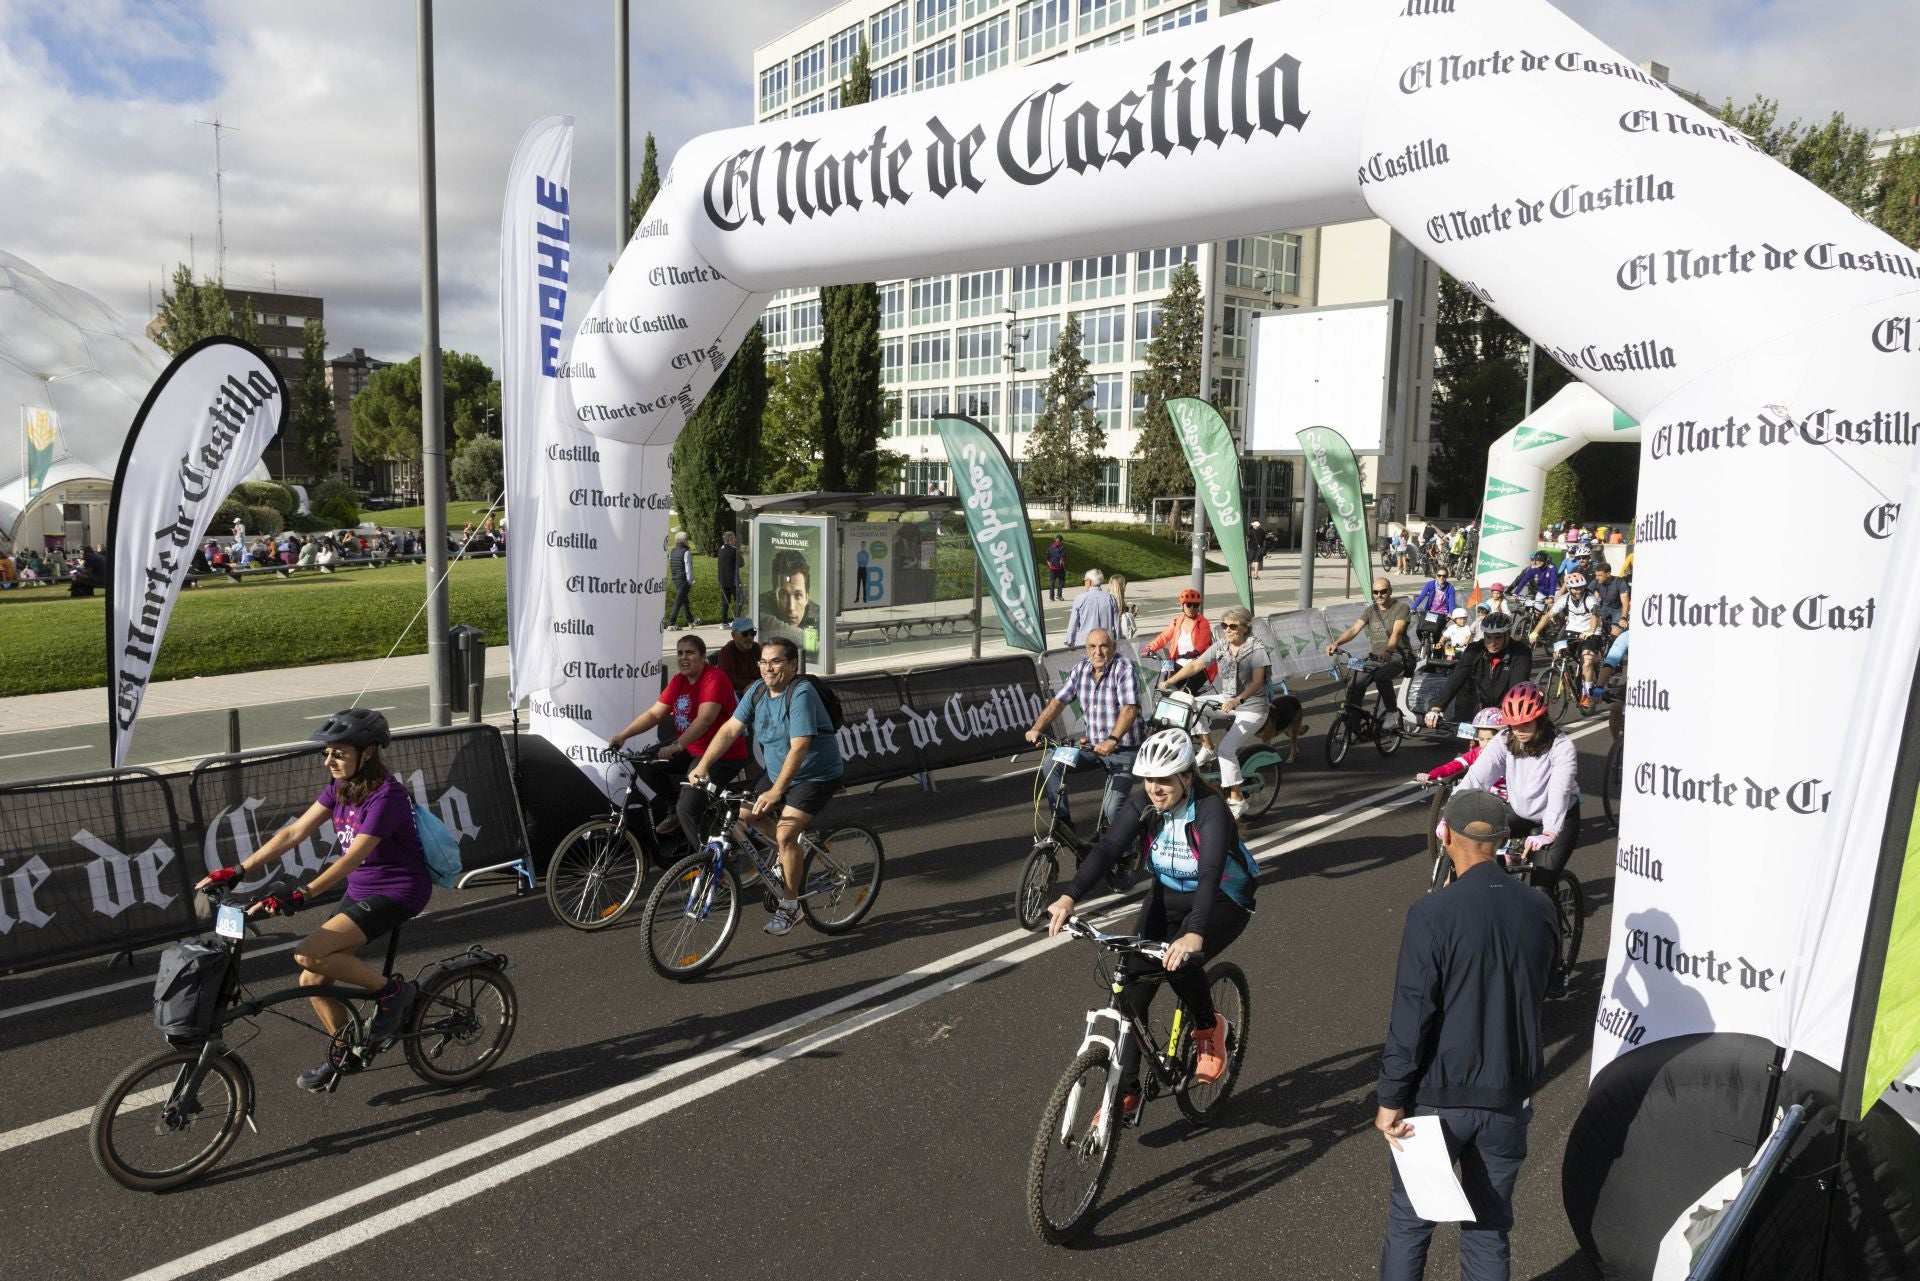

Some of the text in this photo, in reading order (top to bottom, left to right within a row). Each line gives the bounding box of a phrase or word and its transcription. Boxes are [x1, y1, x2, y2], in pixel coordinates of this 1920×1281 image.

[1400, 49, 1664, 94] El Norte de Castilla
[704, 37, 1310, 231] El Norte de Castilla
[1619, 109, 1740, 146] El Norte
[1368, 138, 1450, 182] Castilla
[1426, 174, 1677, 244] El Norte de Castilla
[649, 266, 667, 286] El
[667, 266, 708, 285] Norte
[1616, 254, 1655, 290] El
[1662, 245, 1755, 285] Norte
[1762, 243, 1799, 271] de
[615, 318, 628, 334] de
[629, 314, 688, 334] Castilla
[1872, 317, 1911, 353] El
[671, 353, 692, 369] El
[1581, 339, 1677, 371] Castilla
[577, 402, 654, 421] El Norte de
[179, 369, 279, 503] Castilla
[548, 443, 600, 462] Castilla
[1652, 425, 1672, 460] El
[1677, 415, 1752, 455] Norte
[1757, 414, 1794, 447] de
[569, 489, 588, 506] El
[591, 489, 630, 508] Norte
[632, 493, 646, 509] de
[547, 531, 598, 550] Castilla
[772, 537, 808, 547] PARADIGME
[566, 575, 584, 593] El
[588, 576, 628, 594] Norte
[630, 579, 643, 594] de
[867, 566, 884, 602] B
[124, 547, 180, 664] Norte
[1641, 594, 1662, 629] El
[1667, 594, 1745, 629] Norte
[1749, 596, 1787, 629] de
[553, 617, 594, 636] astilla
[563, 661, 581, 678] El
[584, 662, 624, 679] Norte
[626, 663, 640, 679] de
[118, 669, 147, 731] El
[543, 701, 592, 720] Castilla
[1626, 679, 1670, 713] astilla
[836, 708, 900, 762] orte
[900, 704, 943, 749] de
[566, 744, 583, 761] El
[1635, 762, 1656, 795] El
[1659, 763, 1738, 807] Norte
[1744, 776, 1780, 811] de
[72, 828, 180, 919] de
[1617, 842, 1664, 883] astilla
[1626, 928, 1649, 965] El
[1653, 934, 1732, 985] Norte
[1738, 956, 1775, 992] de
